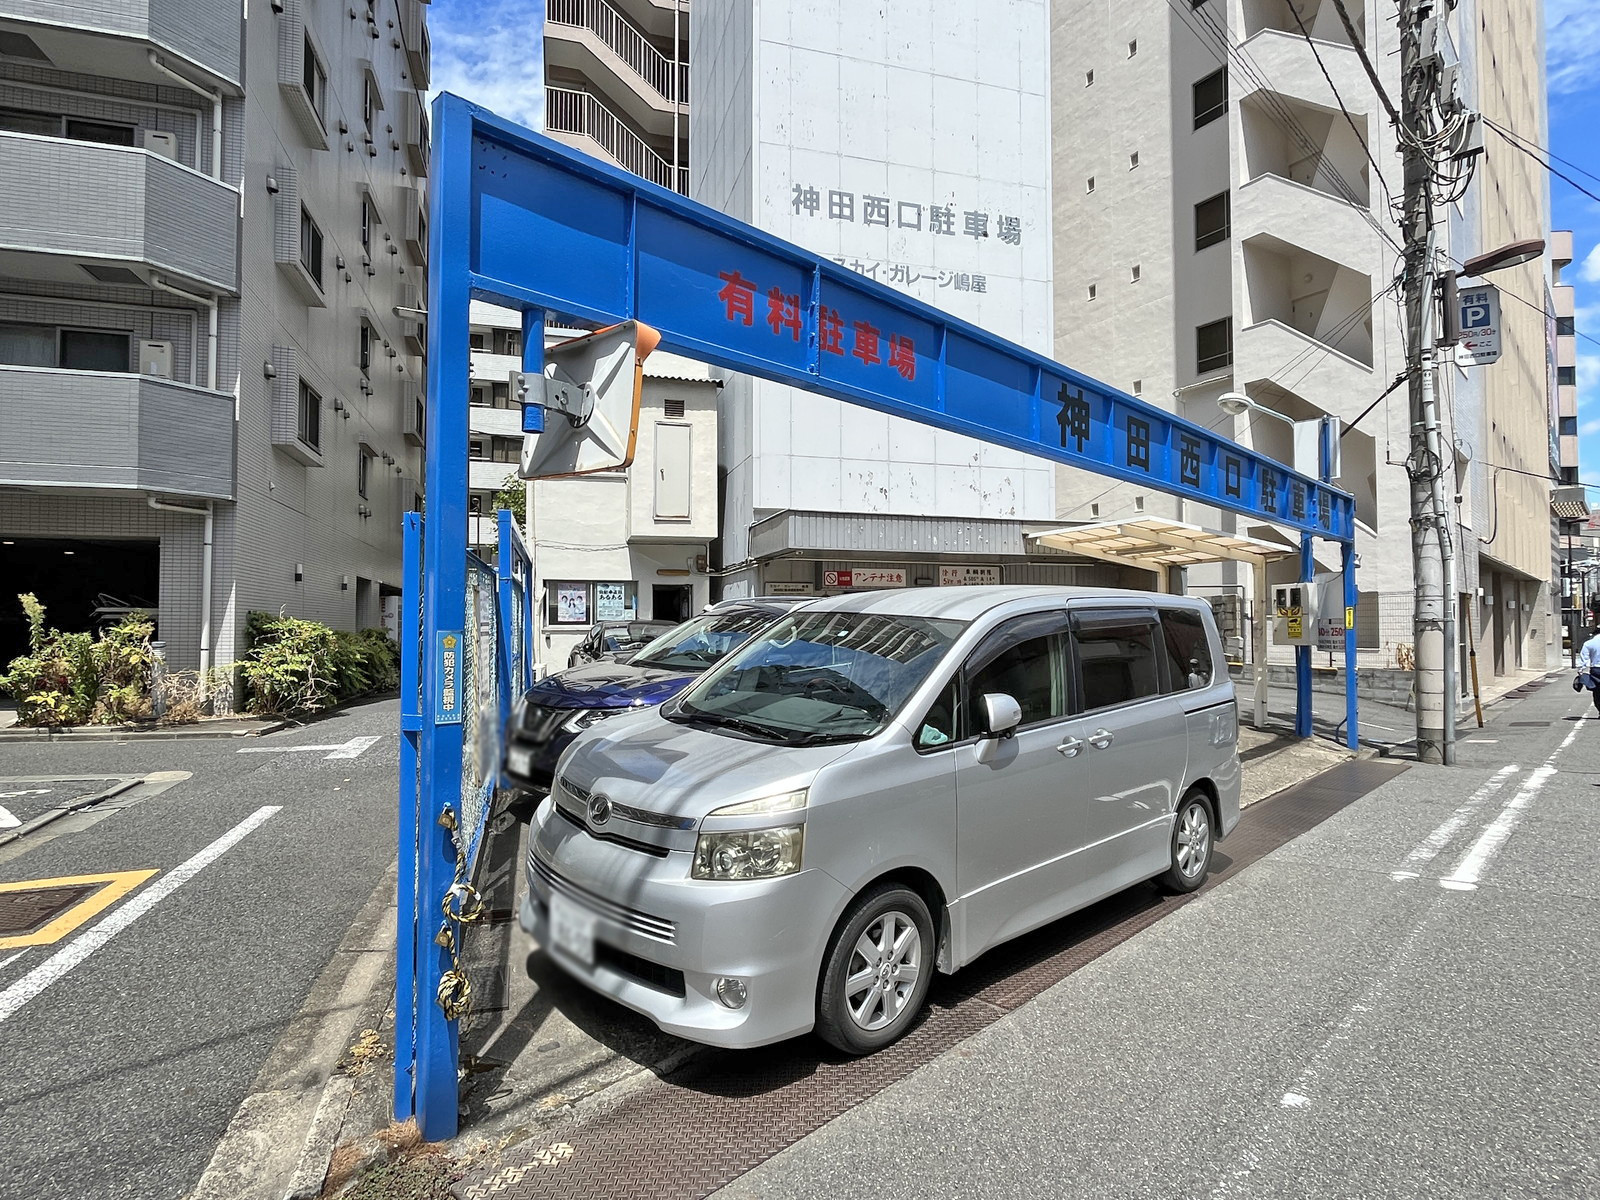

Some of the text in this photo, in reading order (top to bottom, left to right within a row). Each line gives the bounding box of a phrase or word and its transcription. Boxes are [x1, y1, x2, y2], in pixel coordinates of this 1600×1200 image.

[791, 183, 1022, 246] 神田西口駐車場
[718, 270, 917, 381] 有料駐車場
[1462, 292, 1488, 306] 有料
[1466, 307, 1485, 328] P
[1057, 382, 1332, 530] 神田西口駐車場
